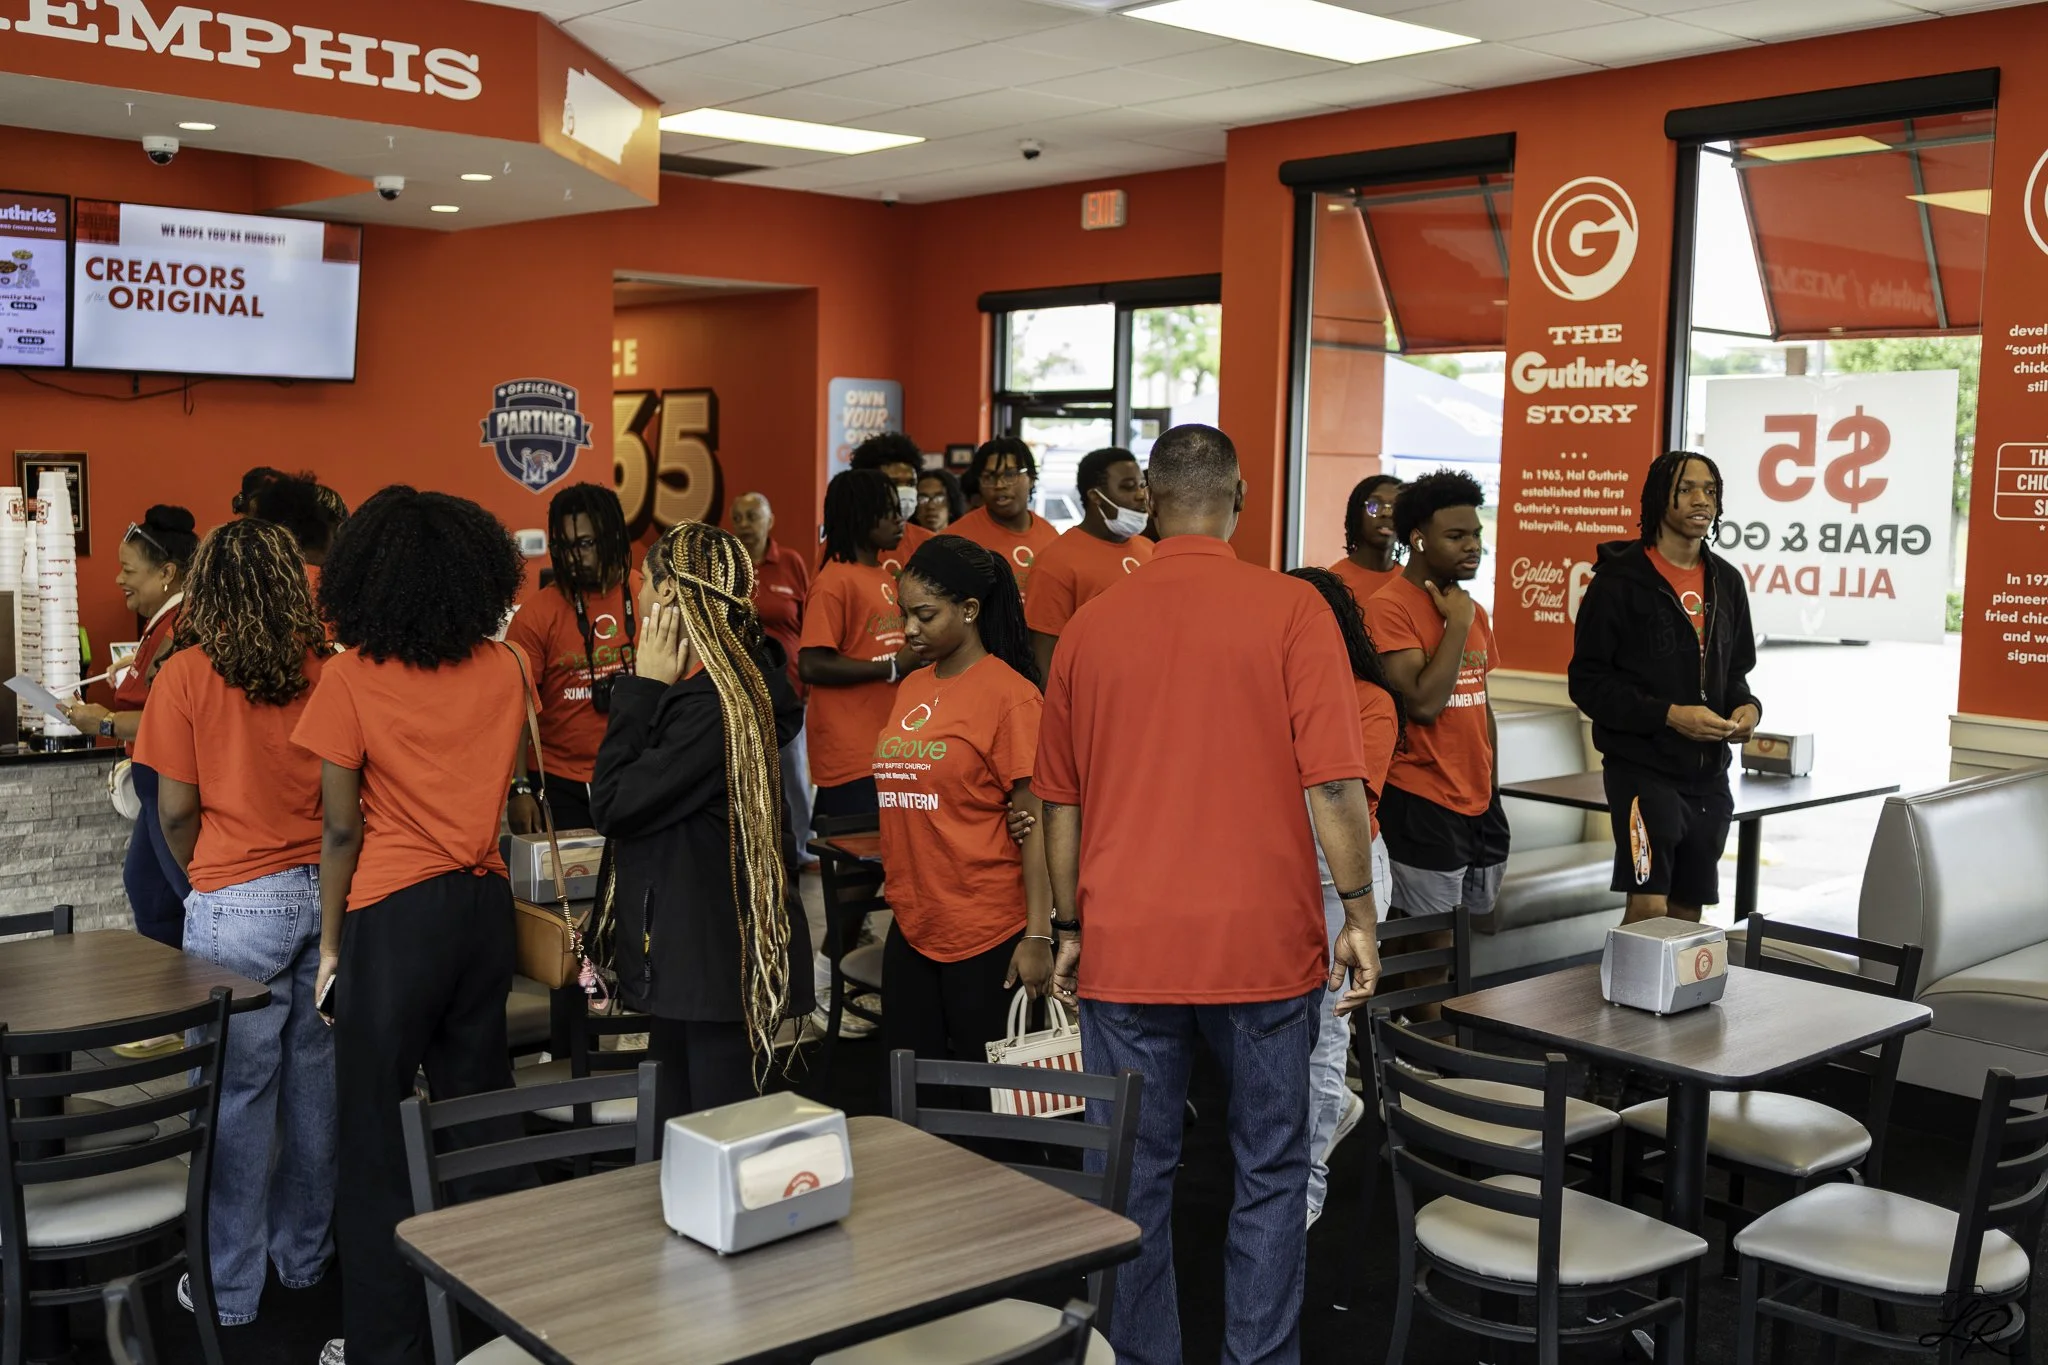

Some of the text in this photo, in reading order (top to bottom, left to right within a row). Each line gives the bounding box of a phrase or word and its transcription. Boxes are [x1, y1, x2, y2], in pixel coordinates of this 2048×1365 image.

[0, 0, 482, 100] EMPHIS
[1088, 192, 1118, 226] EXIT
[161, 222, 286, 246] WE HOPE YOU'RE HUNGRY!
[85, 256, 246, 291] CREATORS
[107, 285, 265, 318] ORIGINAL
[1548, 324, 1623, 345] THE
[2009, 324, 2048, 337] devel
[1511, 350, 1649, 394] Guthrie's
[2013, 361, 2048, 374] chick
[507, 382, 565, 398] OFFICIAL
[2027, 380, 2048, 392] stil
[845, 390, 886, 406] OWN
[842, 406, 888, 429] YOUR
[1526, 404, 1638, 424] STORY
[496, 409, 577, 437] PARTNER
[1522, 469, 1629, 482] In 1965, Hal Guthrie
[1522, 487, 1625, 499] established the first
[1514, 502, 1632, 517] Guthrie's restaurant in
[2034, 499, 2048, 515] S
[1519, 520, 1627, 534] Haleyville, Alabama.
[1511, 557, 1564, 589] Golden
[2006, 573, 2021, 585] In
[1521, 584, 1566, 609] Fried
[1992, 592, 2048, 605] pioneer
[1534, 610, 1565, 623] SINCE
[1985, 609, 2048, 625] fried chic
[2003, 631, 2030, 643] and
[2007, 649, 2048, 664] signa
[876, 736, 947, 760] Grove
[898, 792, 939, 810] INTERN
